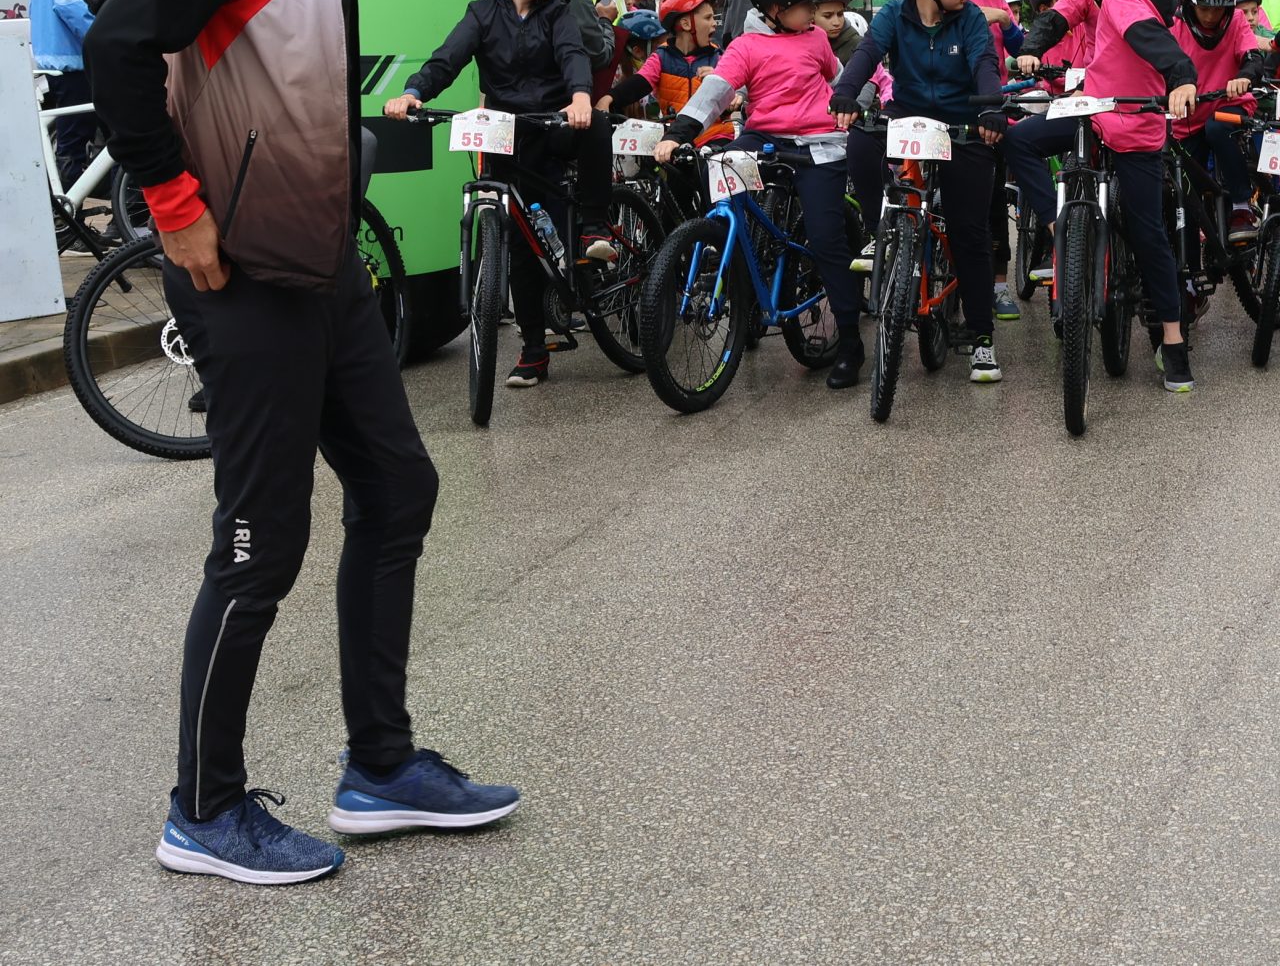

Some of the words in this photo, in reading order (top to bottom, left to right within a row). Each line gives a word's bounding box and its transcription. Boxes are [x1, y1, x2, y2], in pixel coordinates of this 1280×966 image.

[461, 132, 484, 148] 55
[619, 138, 638, 152] 73
[899, 139, 921, 156] 70
[716, 176, 738, 194] 43
